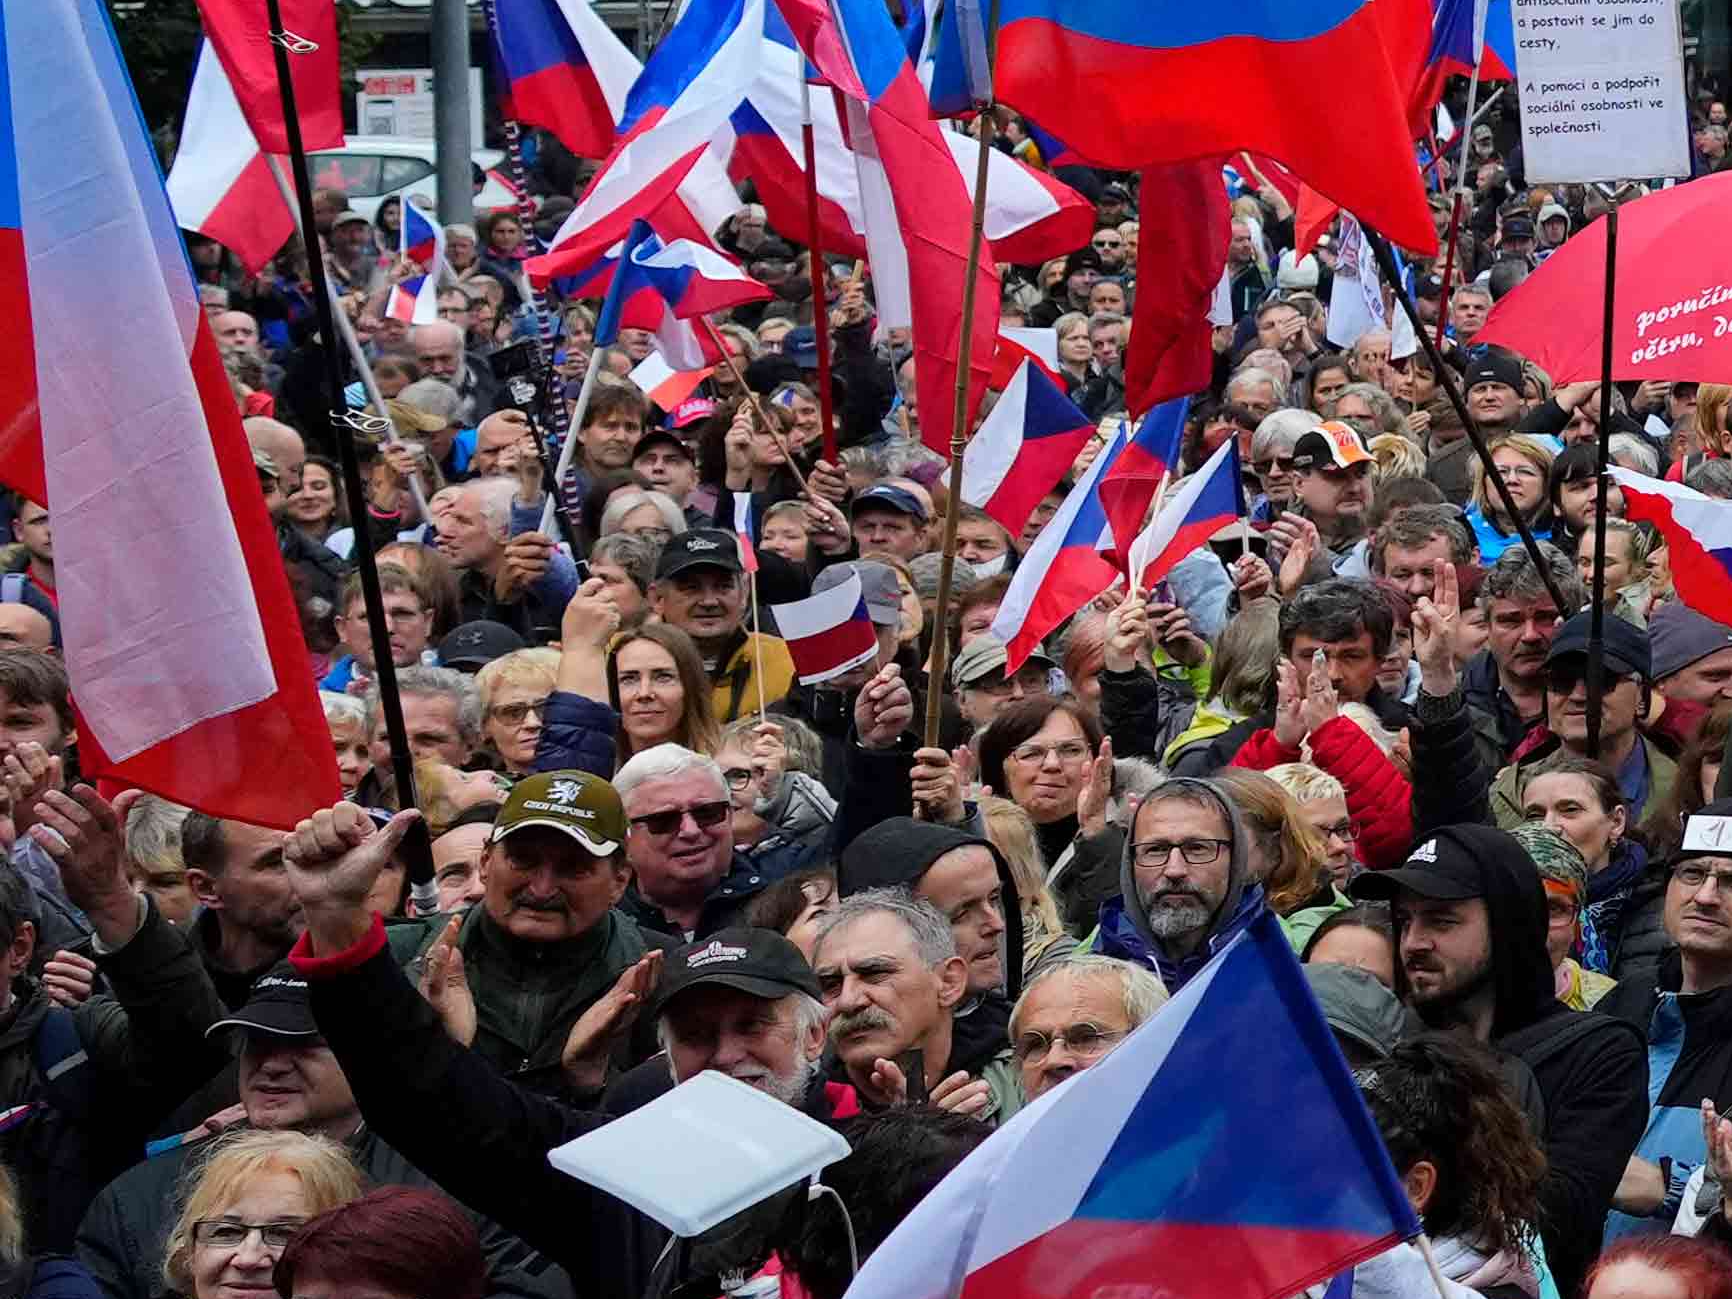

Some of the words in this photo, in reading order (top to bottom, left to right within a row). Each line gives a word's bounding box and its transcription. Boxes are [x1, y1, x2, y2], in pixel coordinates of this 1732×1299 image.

[1517, 20, 1526, 28] a
[1532, 14, 1585, 30] postavit
[1592, 17, 1606, 26] se
[1639, 13, 1655, 25] do
[1525, 82, 1535, 94] A
[1541, 78, 1586, 95] pomoci
[1592, 81, 1600, 91] a
[1606, 76, 1661, 93] podpořit
[1527, 99, 1575, 115] sociální
[1581, 97, 1643, 112] osobnosti
[1648, 99, 1663, 109] ve
[1631, 332, 1704, 365] větru,
